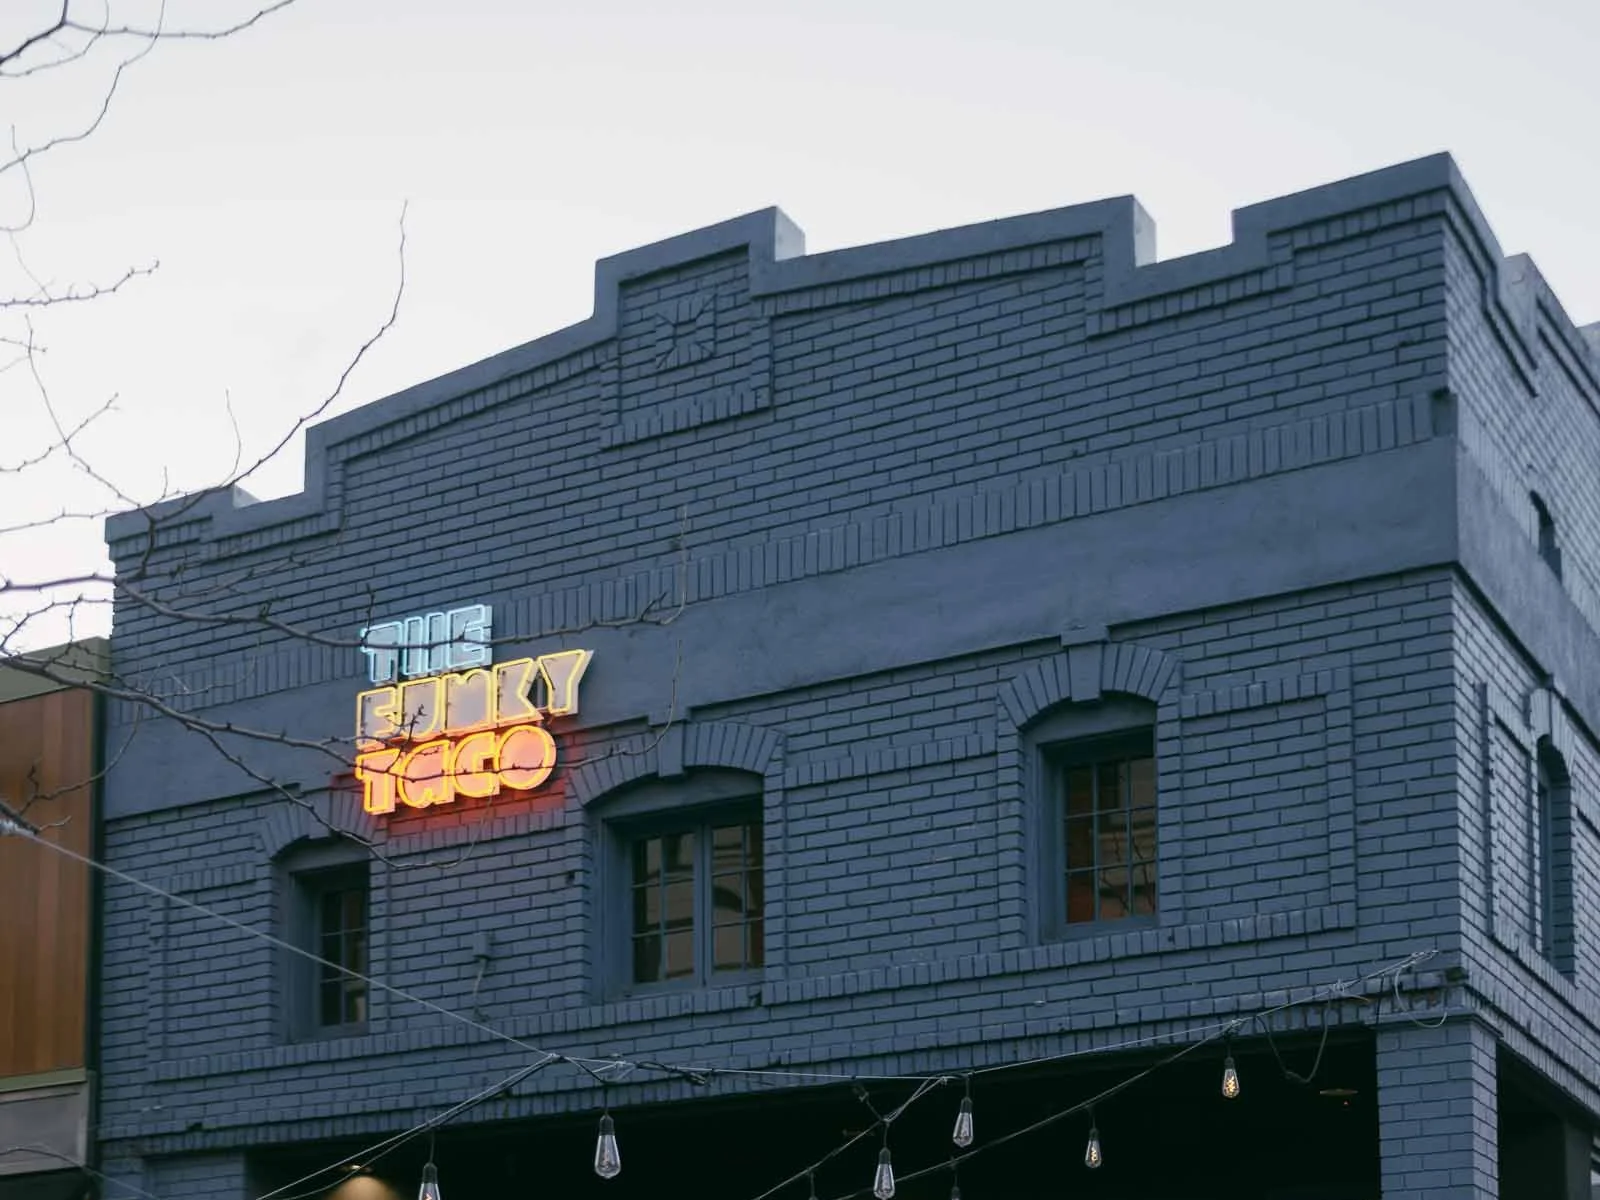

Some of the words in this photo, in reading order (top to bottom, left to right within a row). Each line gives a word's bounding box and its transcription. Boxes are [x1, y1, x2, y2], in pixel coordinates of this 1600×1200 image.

[360, 603, 492, 683] THE
[356, 649, 593, 749] FUNKY
[355, 725, 556, 814] TACO
